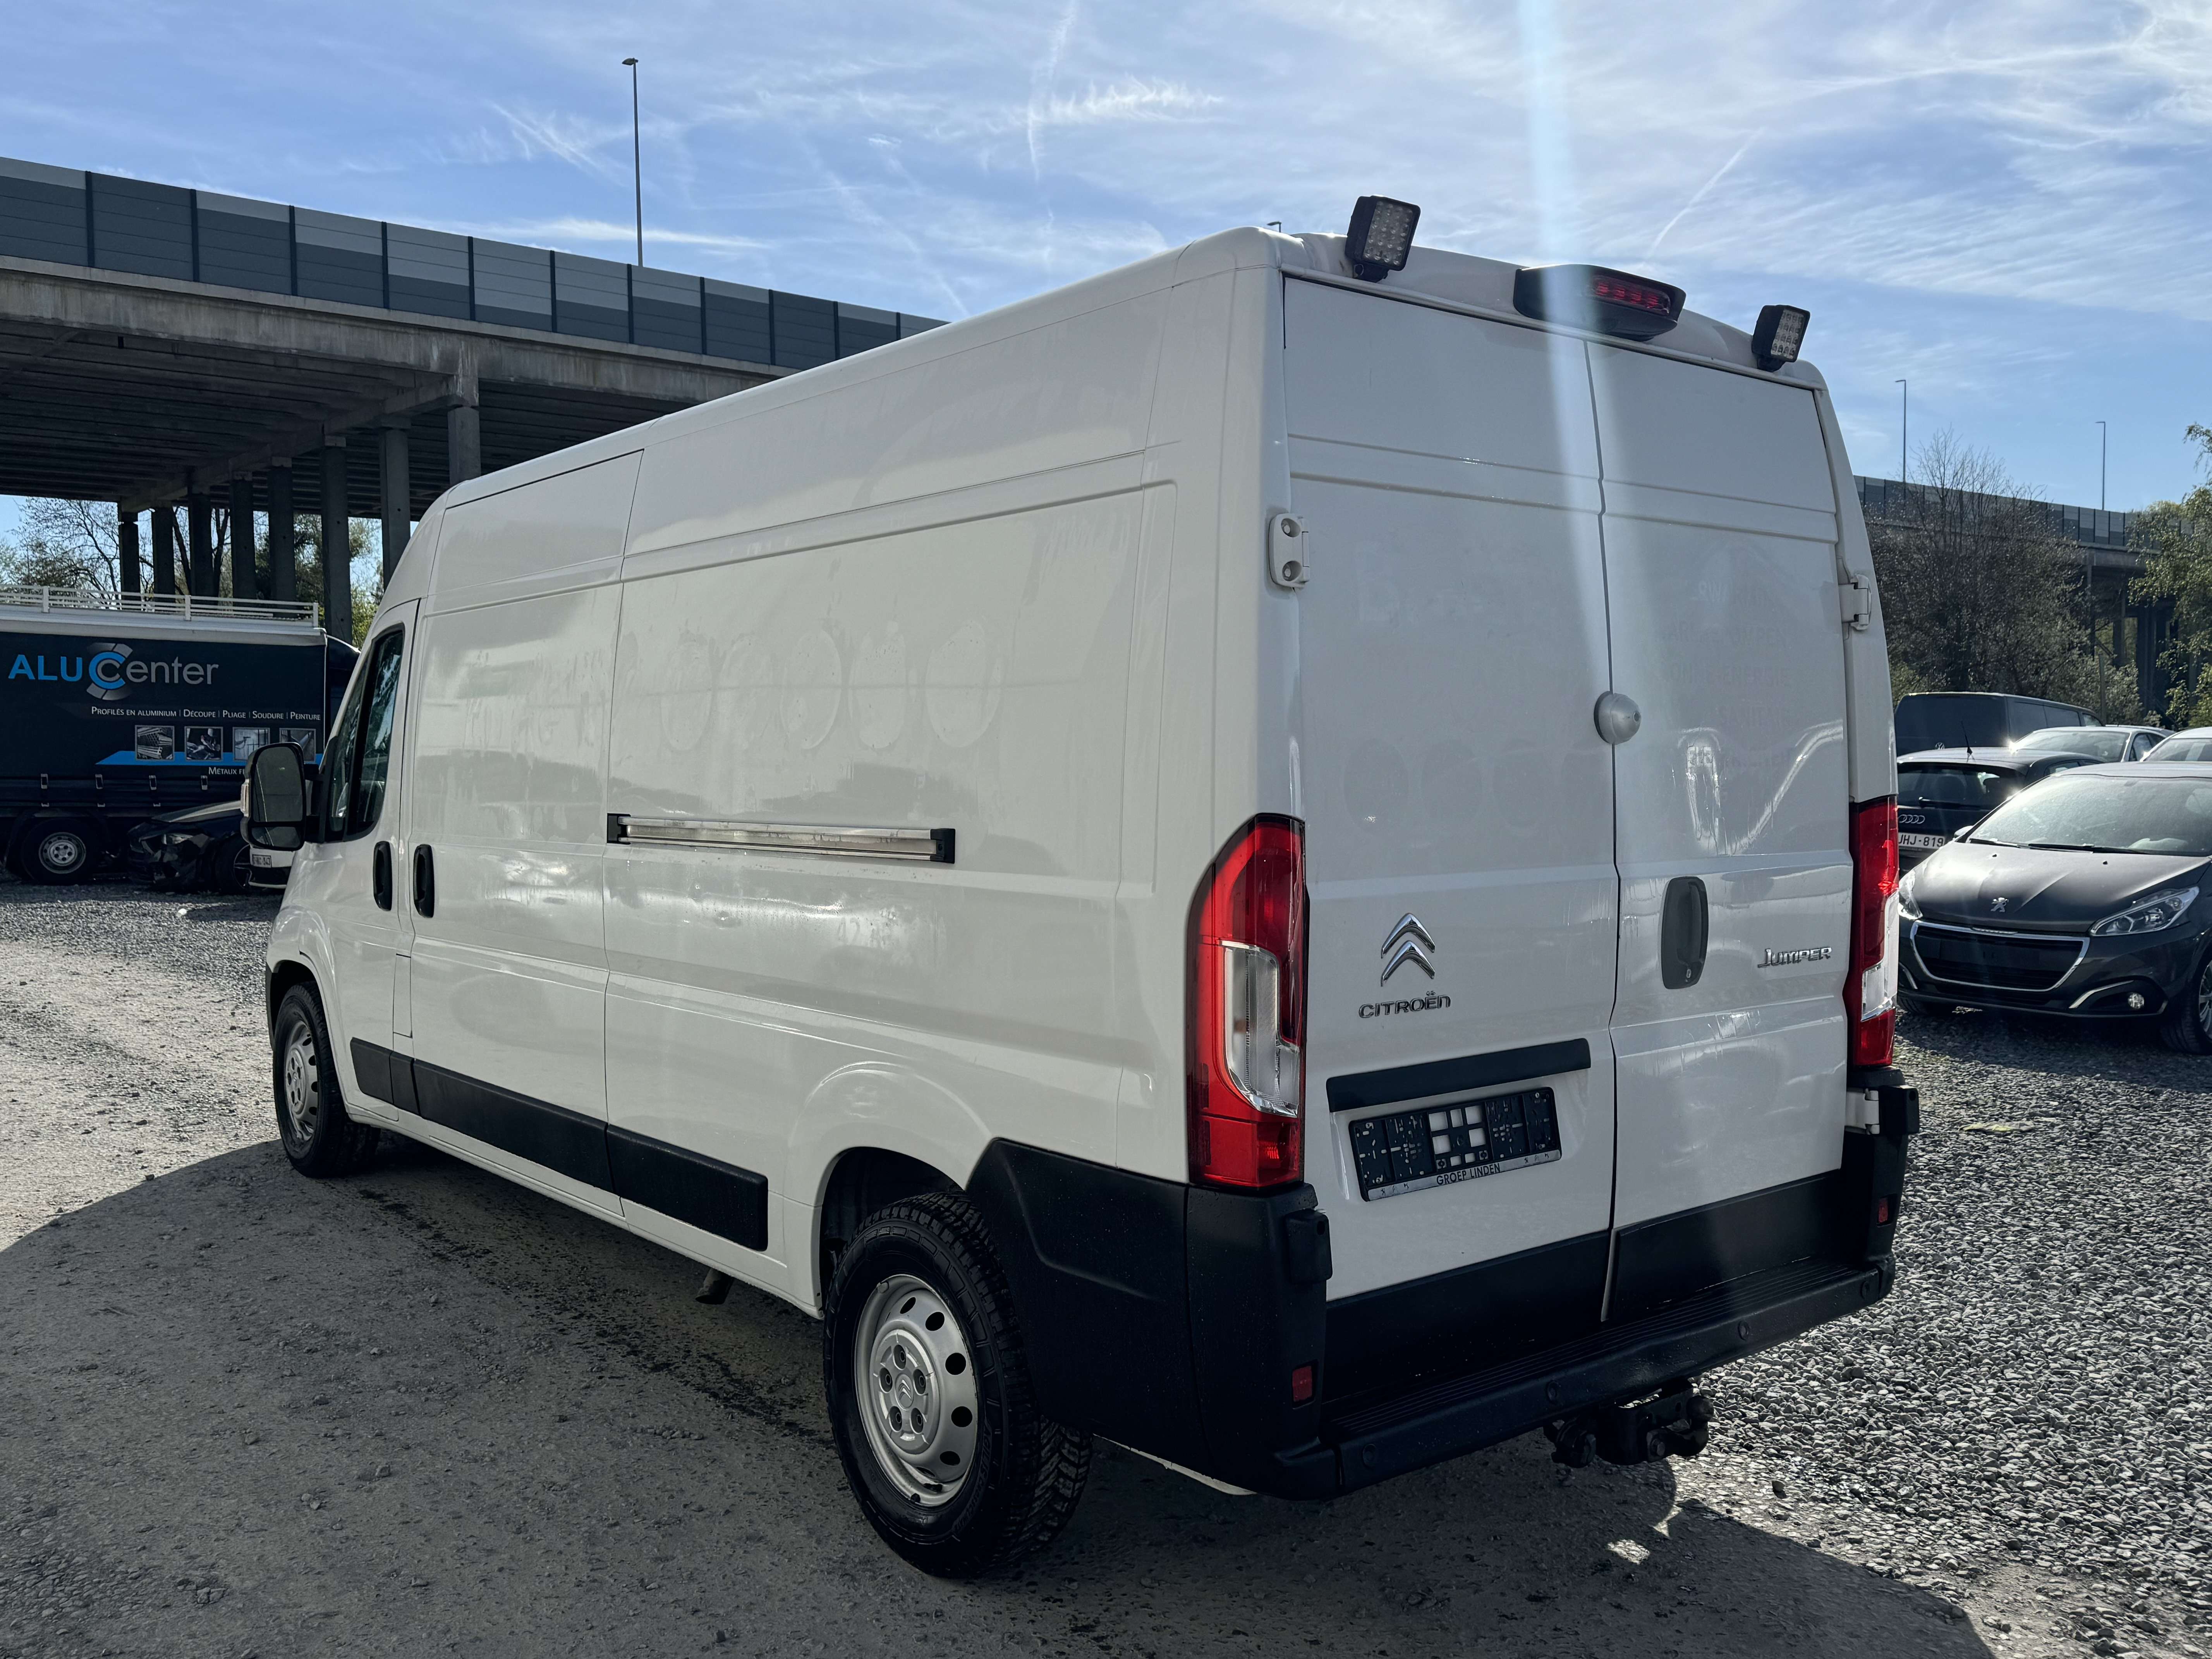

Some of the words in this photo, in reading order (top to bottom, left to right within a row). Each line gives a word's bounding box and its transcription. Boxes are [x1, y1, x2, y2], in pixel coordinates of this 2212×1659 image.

[223, 710, 246, 718] PLIAGE
[252, 711, 283, 719] SOUDURE
[290, 711, 321, 720] PEINTURE
[1436, 1170, 1467, 1185] GROEP
[1470, 1163, 1500, 1178] LINDEN
